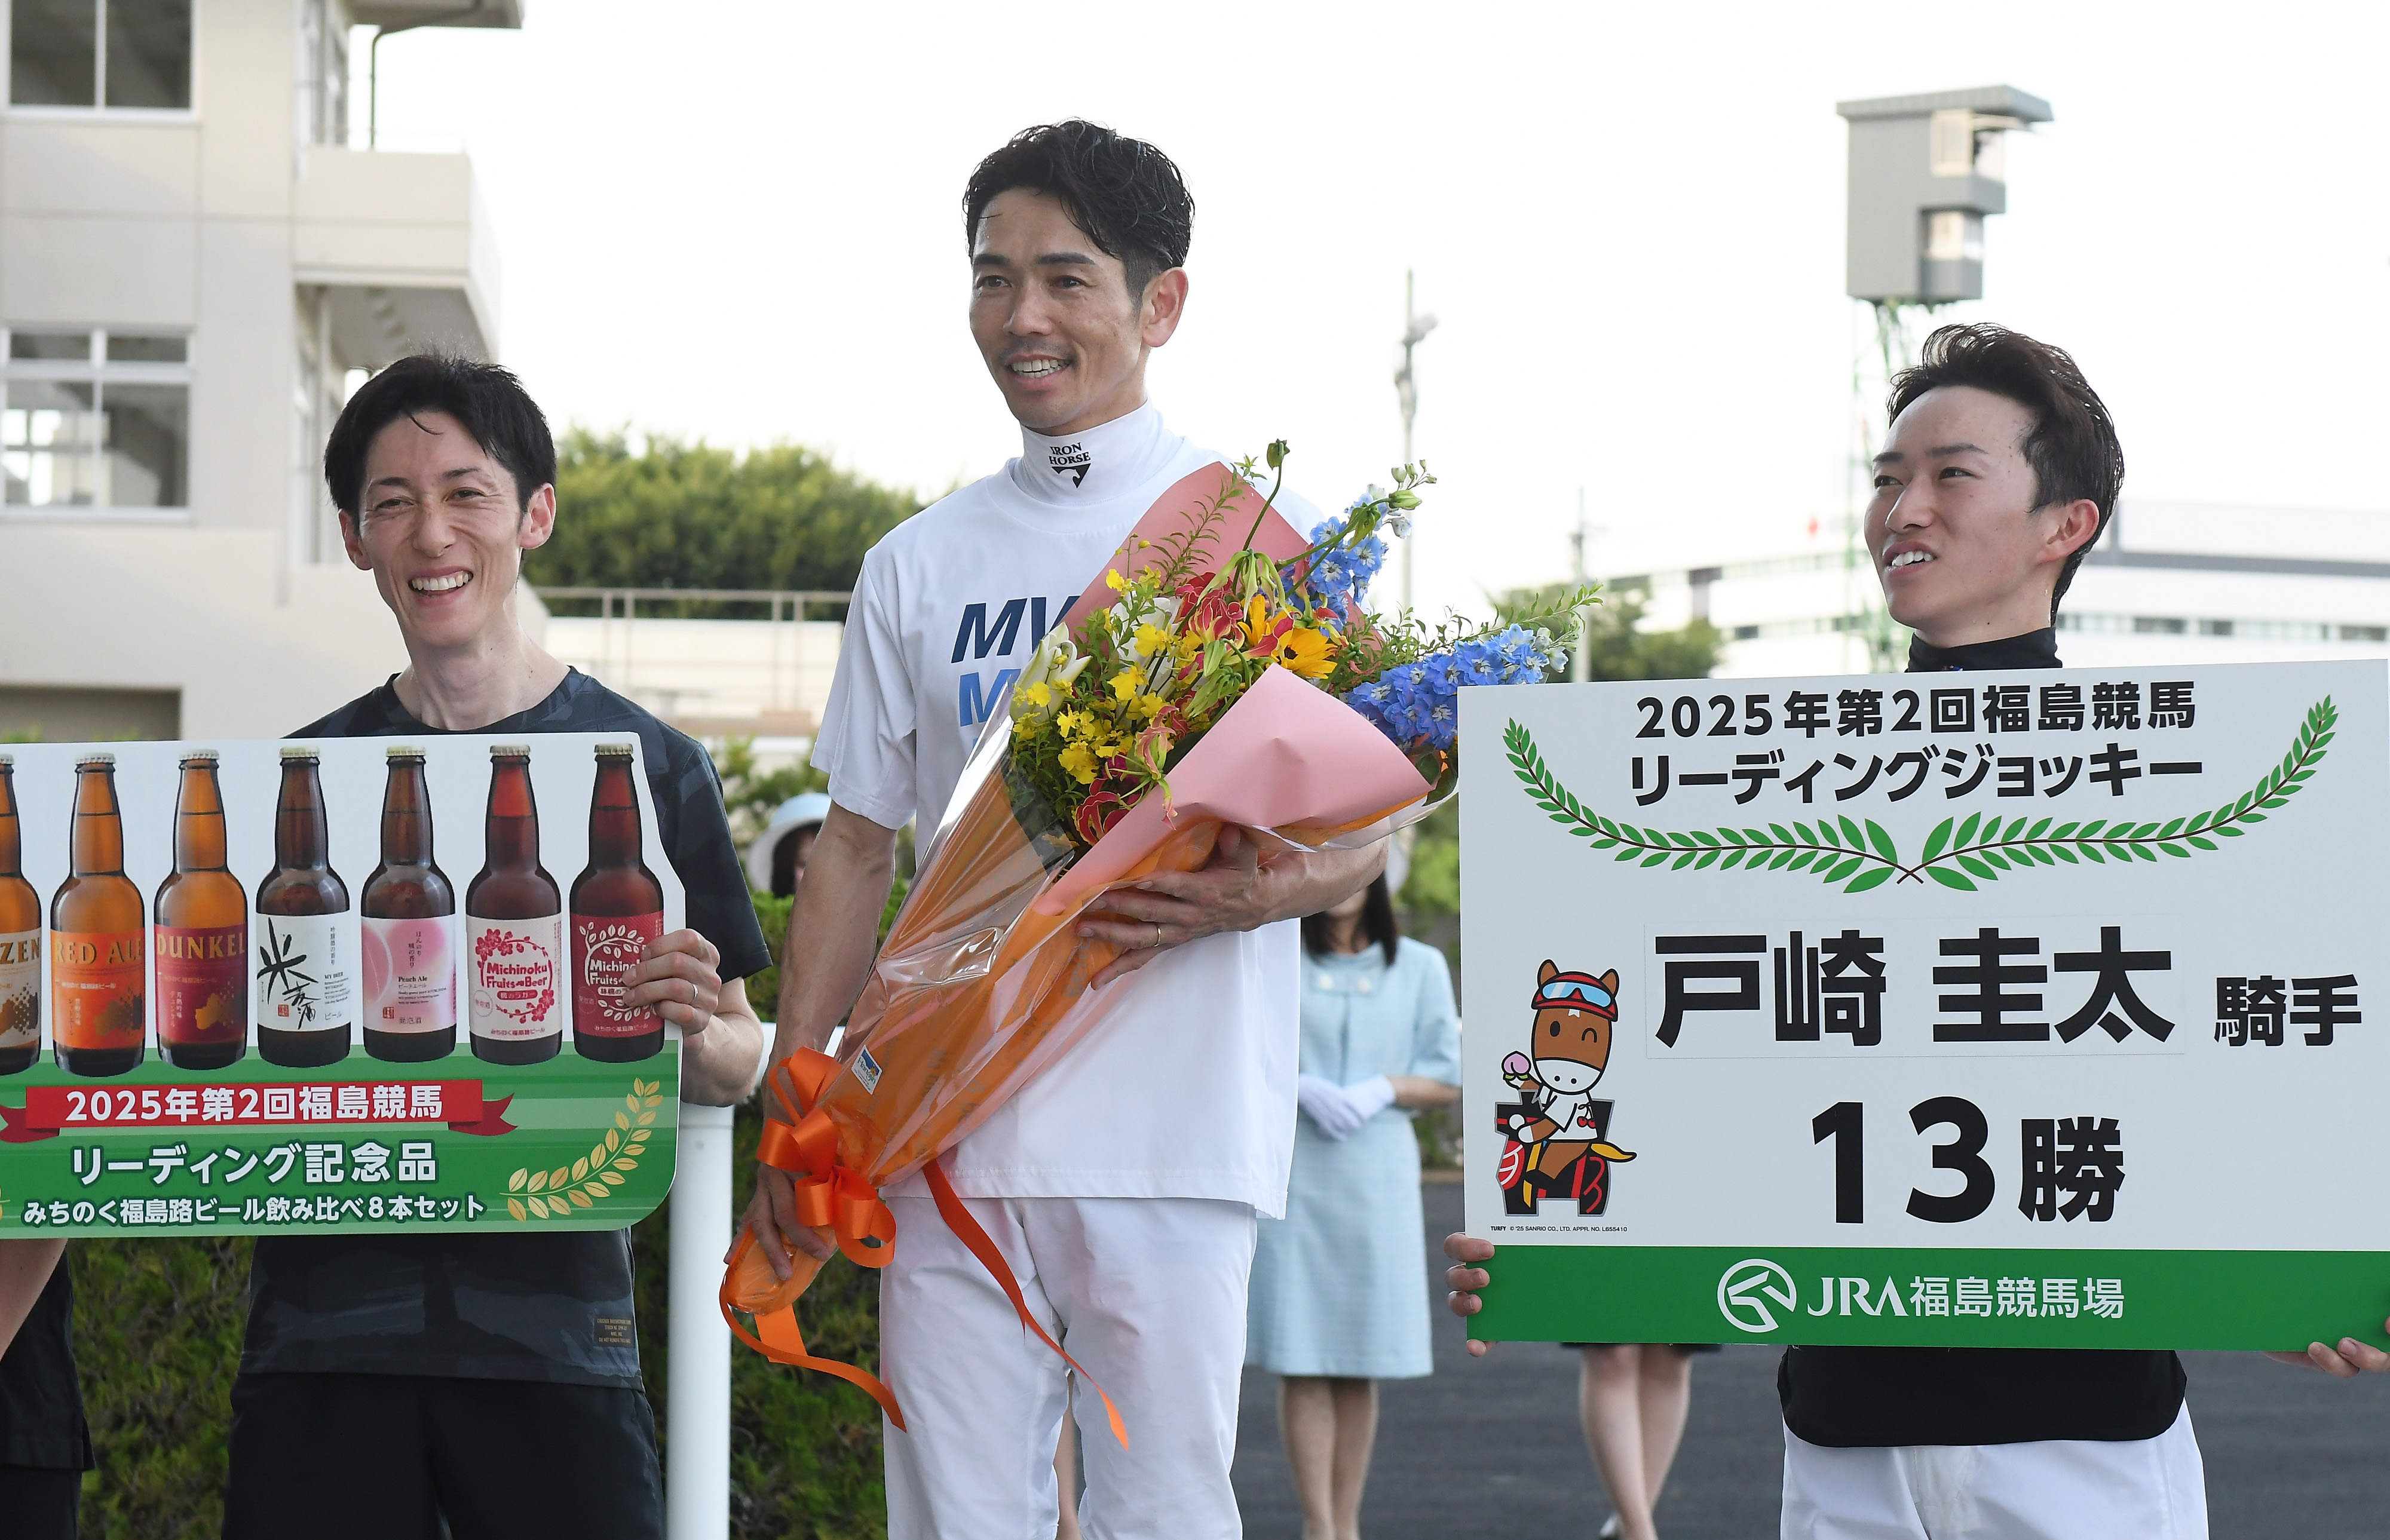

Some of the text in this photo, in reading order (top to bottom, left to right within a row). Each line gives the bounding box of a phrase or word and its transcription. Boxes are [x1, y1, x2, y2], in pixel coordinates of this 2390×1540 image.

[1049, 452, 1091, 465] HORSE
[1050, 442, 1081, 455] IRON
[1636, 681, 2195, 738] 2025年第2回福島競馬
[1632, 743, 2202, 806] リーディングジョッキー
[56, 941, 97, 965] RED
[157, 932, 245, 959] DUNKEL
[486, 962, 548, 975] Michinoku
[590, 972, 618, 985] Fruits
[486, 975, 548, 988] Fruits Beer
[1655, 926, 2362, 1048] 戸崎 圭太 騎手
[66, 1085, 442, 1122] 2025年第2回福島競馬
[74, 1142, 436, 1185] リーディング記念品
